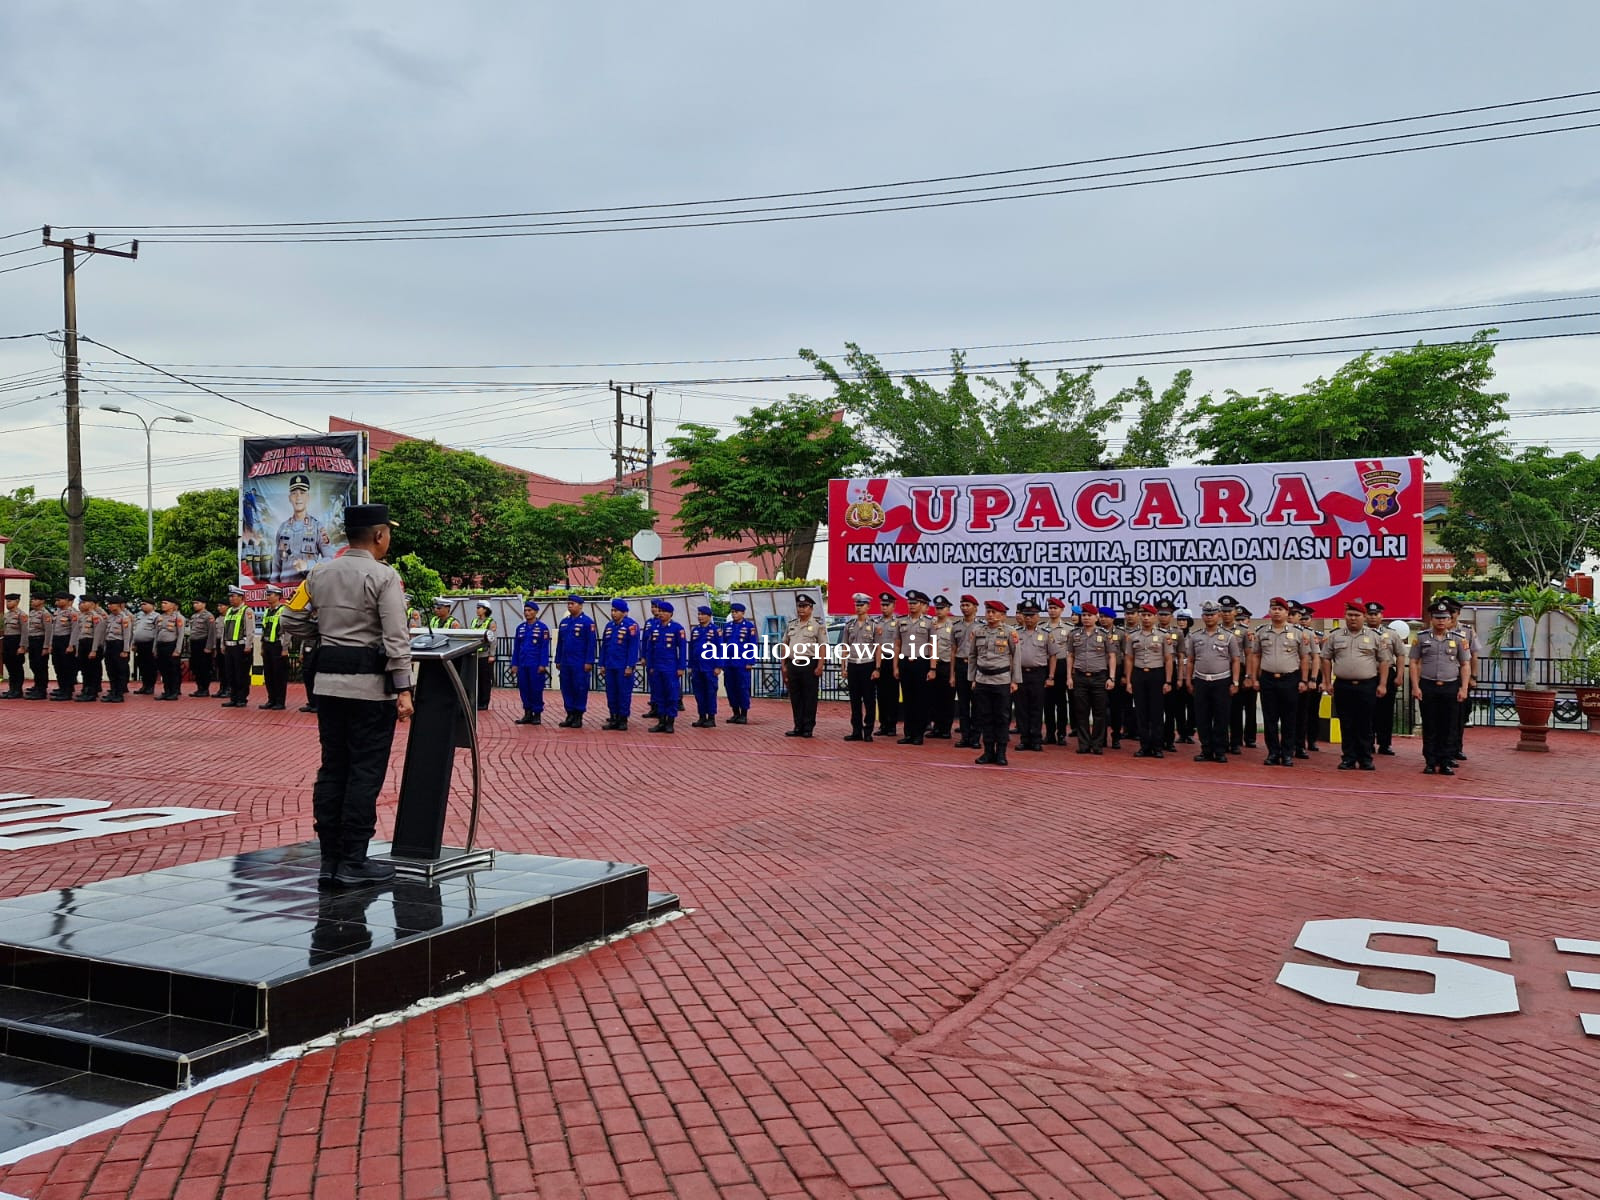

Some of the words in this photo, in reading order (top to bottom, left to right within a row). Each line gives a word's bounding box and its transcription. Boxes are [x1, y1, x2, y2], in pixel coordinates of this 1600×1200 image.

[247, 458, 306, 478] BONTANG
[308, 457, 357, 474] PRESISI
[909, 472, 1327, 534] UPACARA
[847, 542, 939, 564] KENAIKAN
[942, 541, 1031, 563] PANGKAT
[1035, 541, 1132, 566] PERWIRA,
[1134, 538, 1228, 562] BINTARA
[1232, 537, 1280, 560] DAN
[1283, 535, 1332, 560] ASN
[1337, 534, 1409, 559] POLRI
[962, 566, 1064, 588] PERSONEL
[1066, 565, 1147, 588] POLRES
[1150, 563, 1257, 588] BONTANG
[1068, 590, 1081, 608] 1
